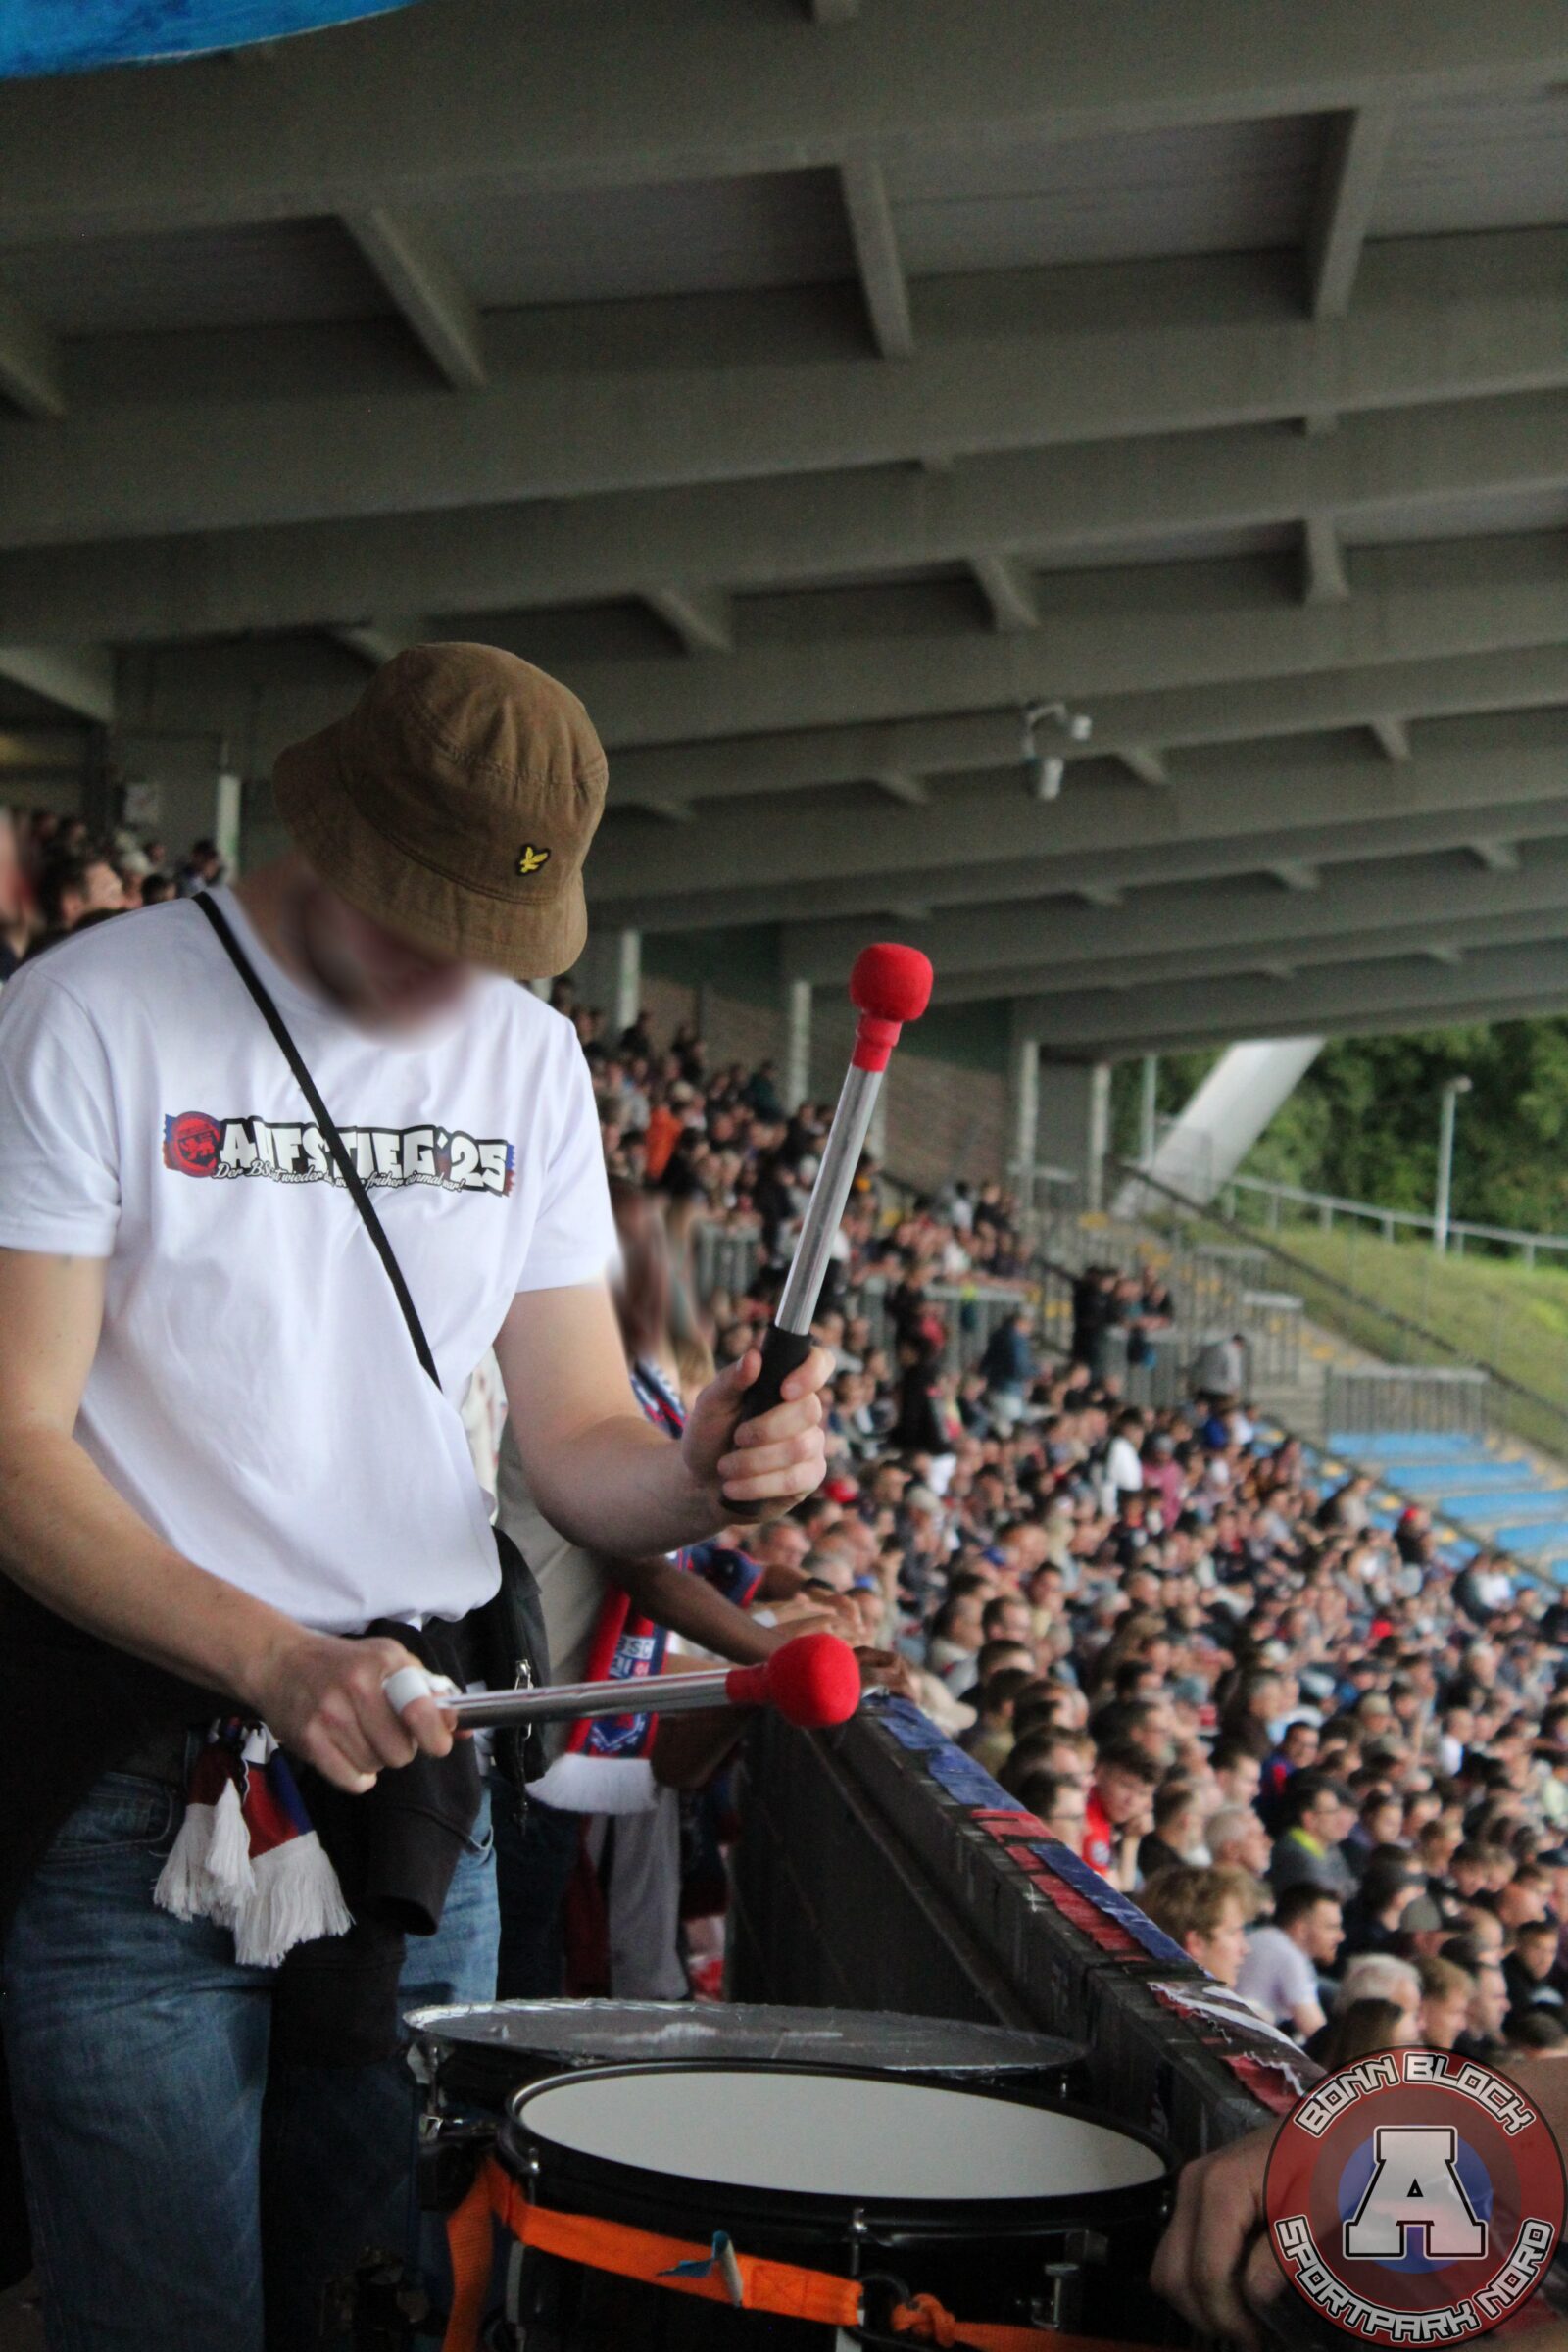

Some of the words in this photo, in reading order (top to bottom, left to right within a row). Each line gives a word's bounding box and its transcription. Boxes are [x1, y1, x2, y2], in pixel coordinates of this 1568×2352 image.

[214, 1161, 243, 1179] Der
[246, 1159, 273, 1178] BS
[280, 1165, 323, 1183] wieder
[365, 1170, 403, 1191] früher
[406, 1170, 444, 1186] einmal
